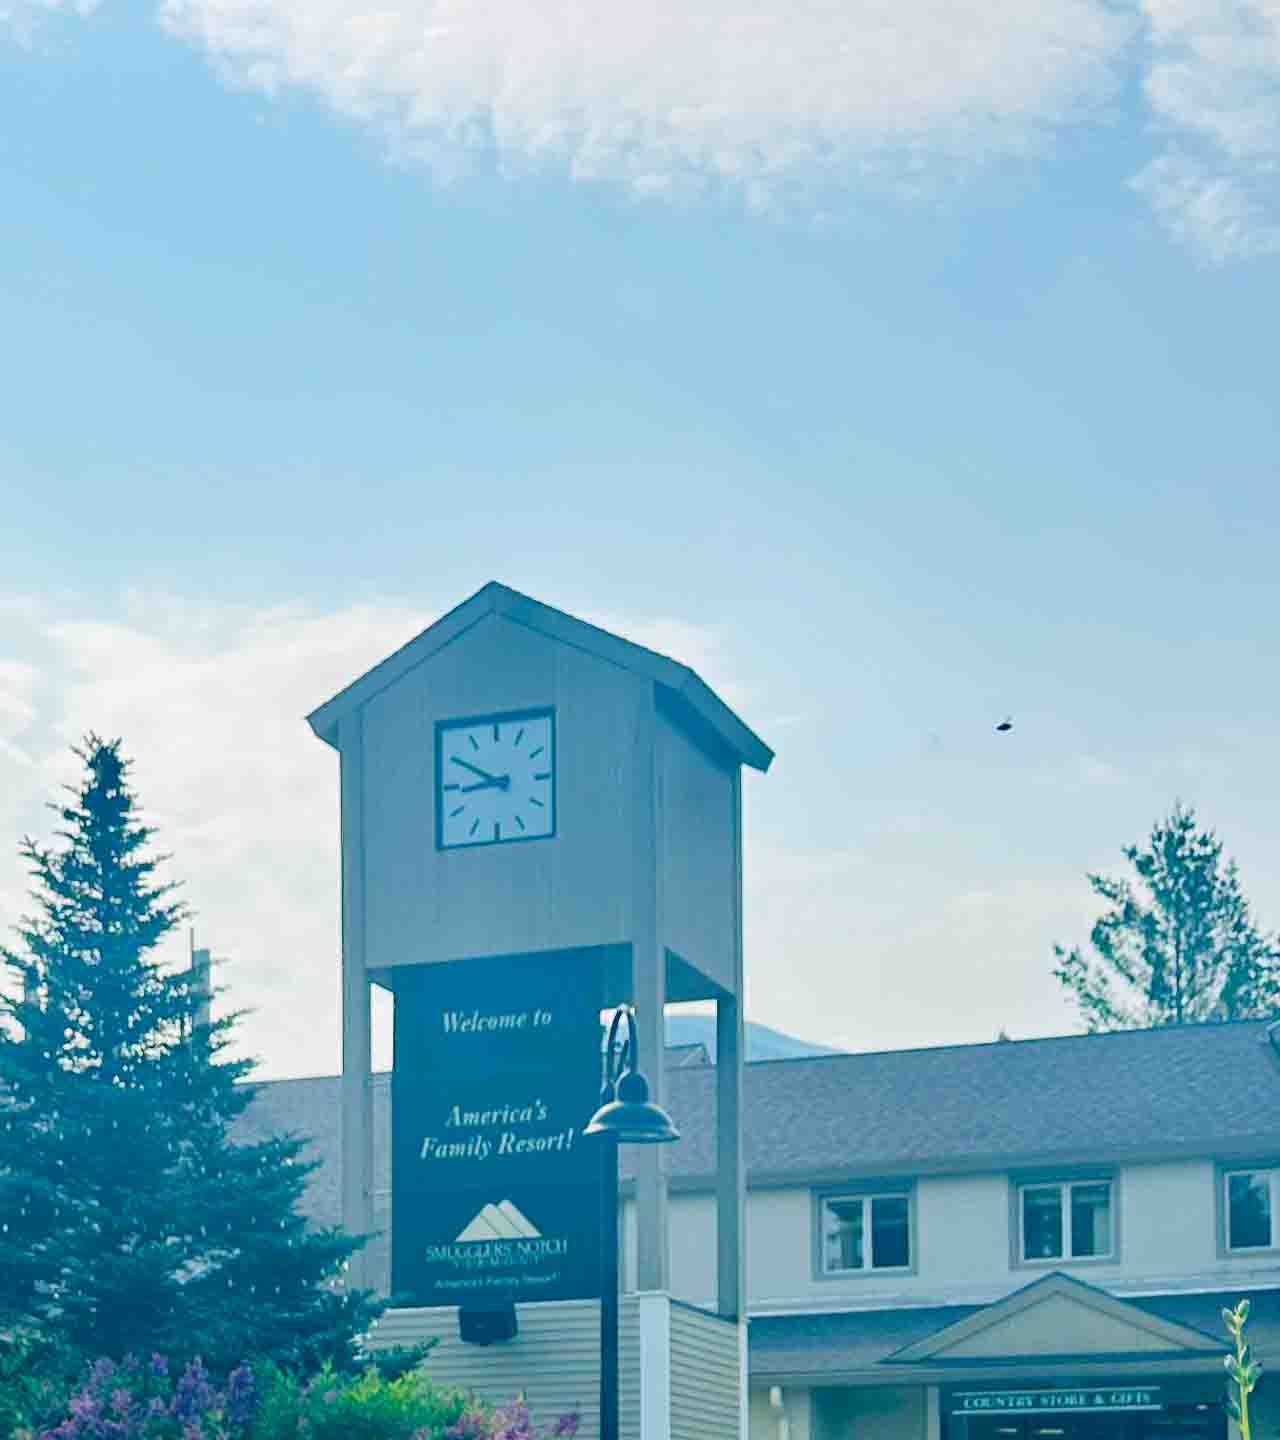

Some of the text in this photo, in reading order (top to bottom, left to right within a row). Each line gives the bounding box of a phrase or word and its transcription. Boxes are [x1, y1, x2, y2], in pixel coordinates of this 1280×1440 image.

[442, 1008, 552, 1033] Welcome to
[444, 1098, 548, 1128] America's
[420, 1127, 575, 1161] Family Resort!
[963, 1390, 1151, 1409] COUNTRY STORE & GIFTS
